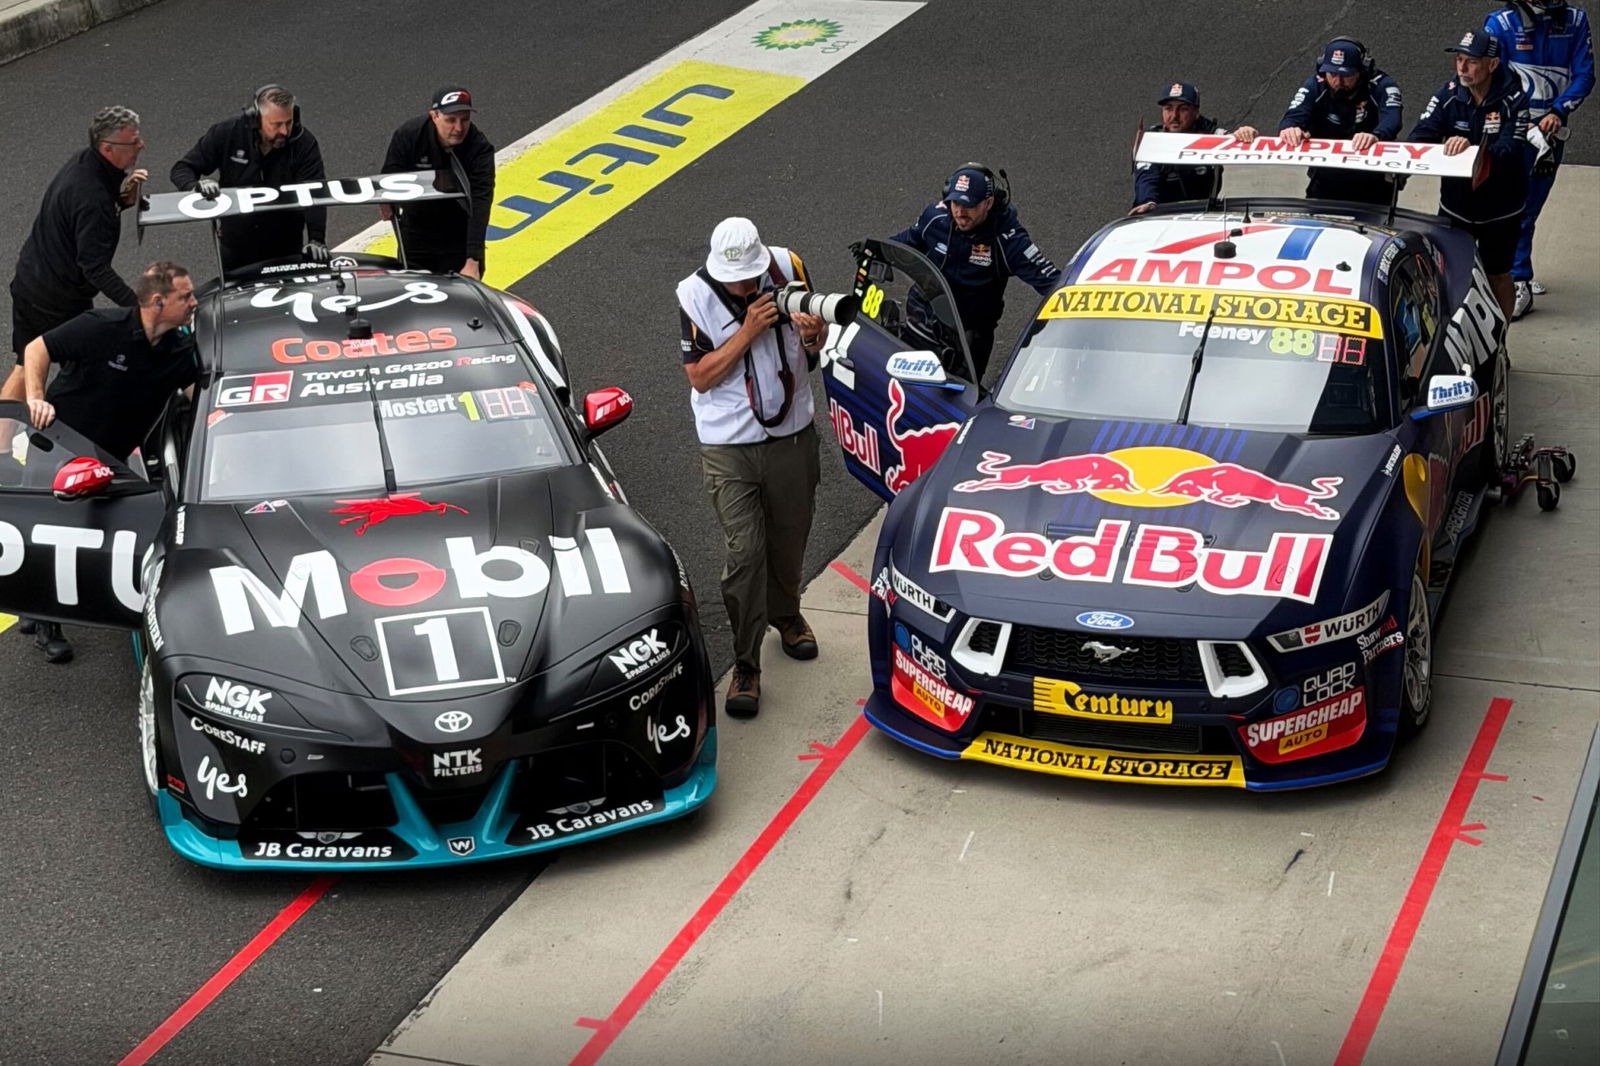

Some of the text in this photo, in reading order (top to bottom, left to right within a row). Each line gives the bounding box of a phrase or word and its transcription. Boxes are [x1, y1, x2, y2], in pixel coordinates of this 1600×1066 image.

[1178, 150, 1430, 171] Premium Fuels
[178, 173, 426, 218] OPTUS
[1087, 257, 1353, 296] AMPOL
[250, 281, 449, 324] yes
[862, 283, 884, 319] 88
[1050, 291, 1369, 331] NATIONAL STORAGE
[271, 327, 458, 365] Coates
[1178, 321, 1316, 356] Feeney 88
[301, 354, 516, 383] TOYOTA GAZOO Racing
[893, 357, 941, 377] Thrifty
[219, 373, 444, 406] GR Australia
[380, 391, 480, 421] Mostert 1
[1430, 380, 1475, 400] Thrifty
[929, 507, 1333, 605] Red Bull
[209, 527, 632, 636] Mobil
[1086, 612, 1125, 628] Ford
[1324, 601, 1380, 638] WÜRTH
[414, 616, 460, 682] 1
[608, 628, 668, 675] NGK
[624, 648, 671, 681] SPARK PLUGS
[895, 650, 973, 716] SUPERCHEAP
[1303, 661, 1356, 693] QUAD
[1303, 674, 1356, 708] LOCK
[204, 700, 264, 723] SPARK PLUGS
[205, 676, 272, 716] NGK
[915, 687, 944, 713] AUTO
[1038, 677, 1173, 721] Century
[646, 714, 691, 754] yes
[1247, 691, 1362, 748] SUPERCHEAP
[1283, 729, 1323, 749] AUTO
[433, 748, 482, 770] NTK
[434, 763, 482, 778] FILTERS
[982, 737, 1228, 779] NATIONAL STORAGE
[197, 755, 248, 800] yes
[526, 798, 654, 841] JB Caravans
[254, 841, 392, 859] JB Caravans
